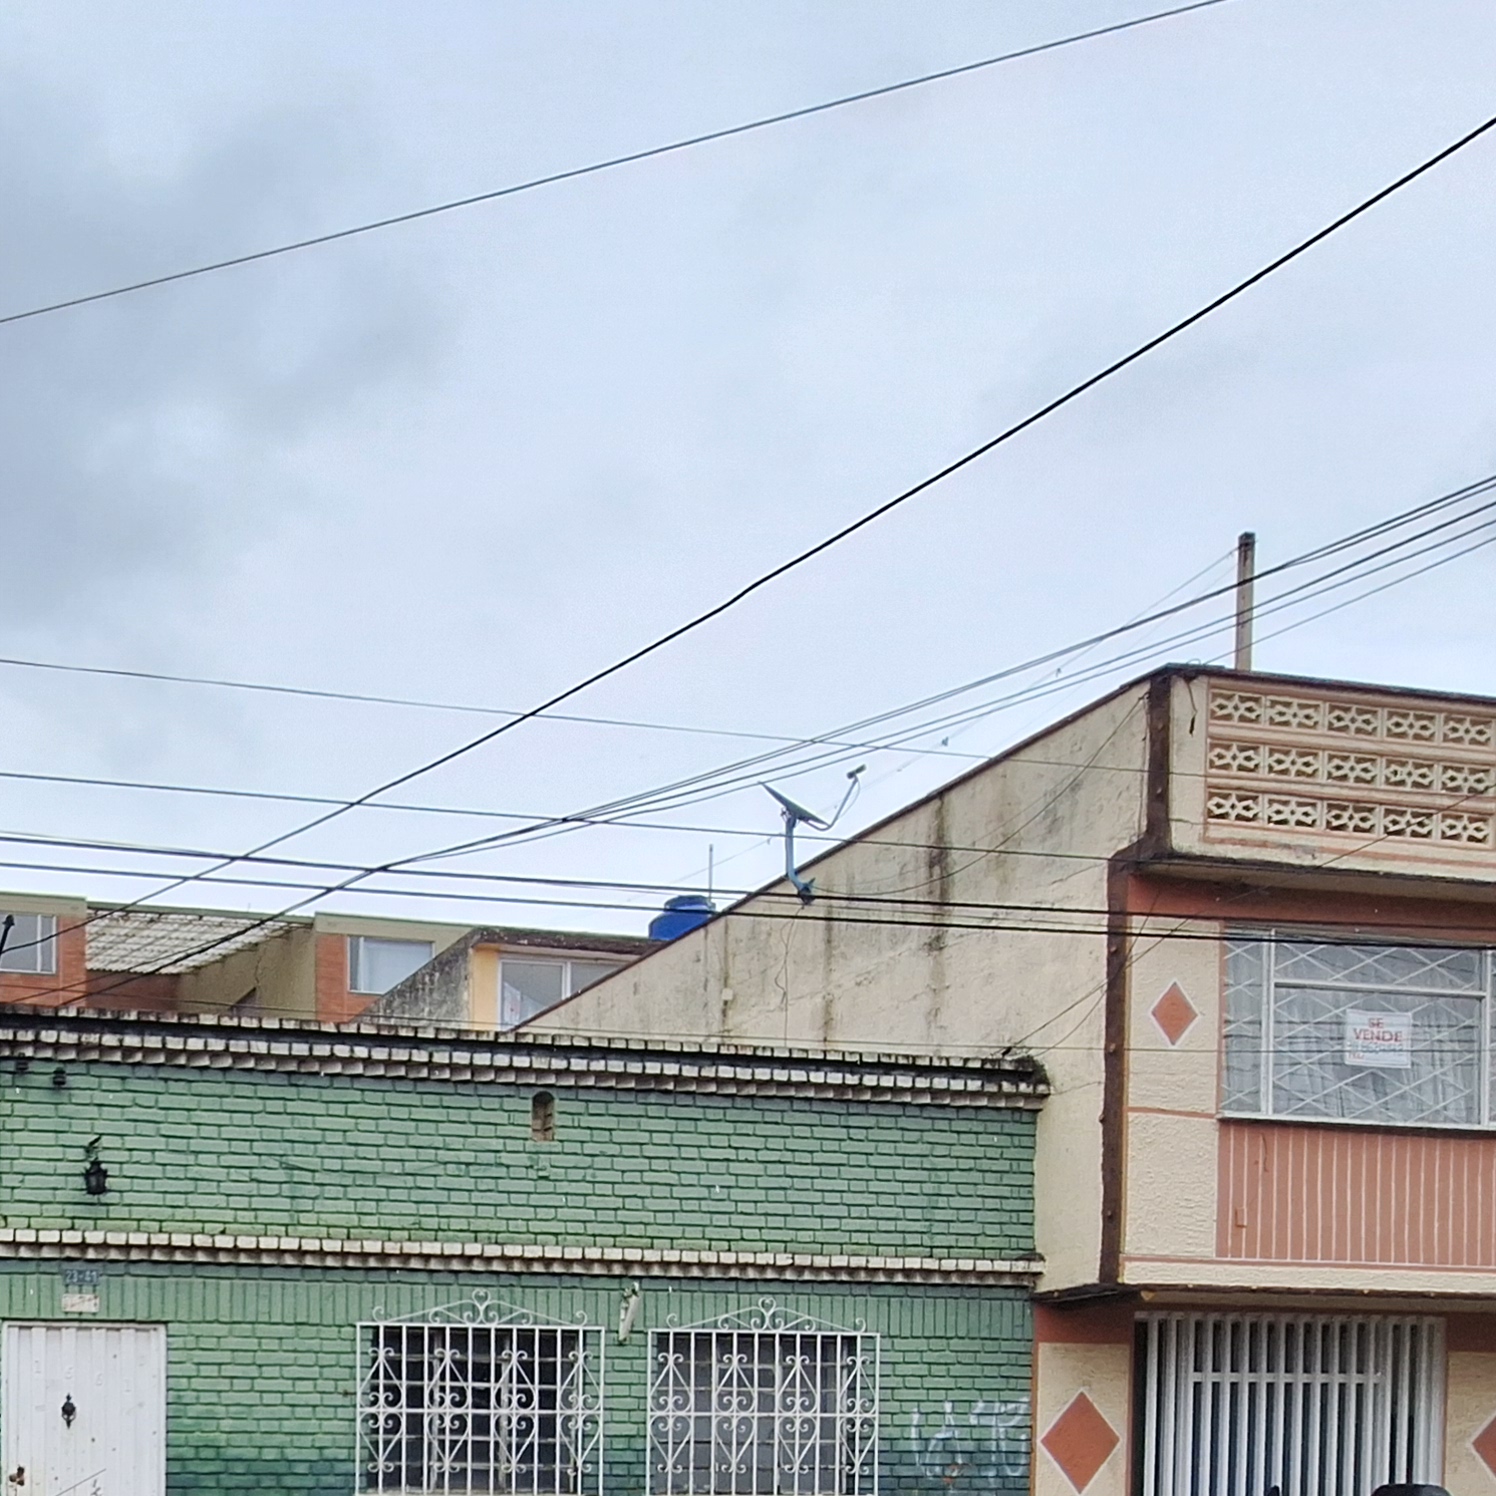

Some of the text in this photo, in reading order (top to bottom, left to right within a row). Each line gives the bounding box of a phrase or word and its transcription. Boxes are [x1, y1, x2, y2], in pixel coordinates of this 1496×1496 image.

[1368, 1017, 1384, 1029] SE
[1352, 1028, 1403, 1043] VENDE
[65, 1270, 98, 1283] 23-41
